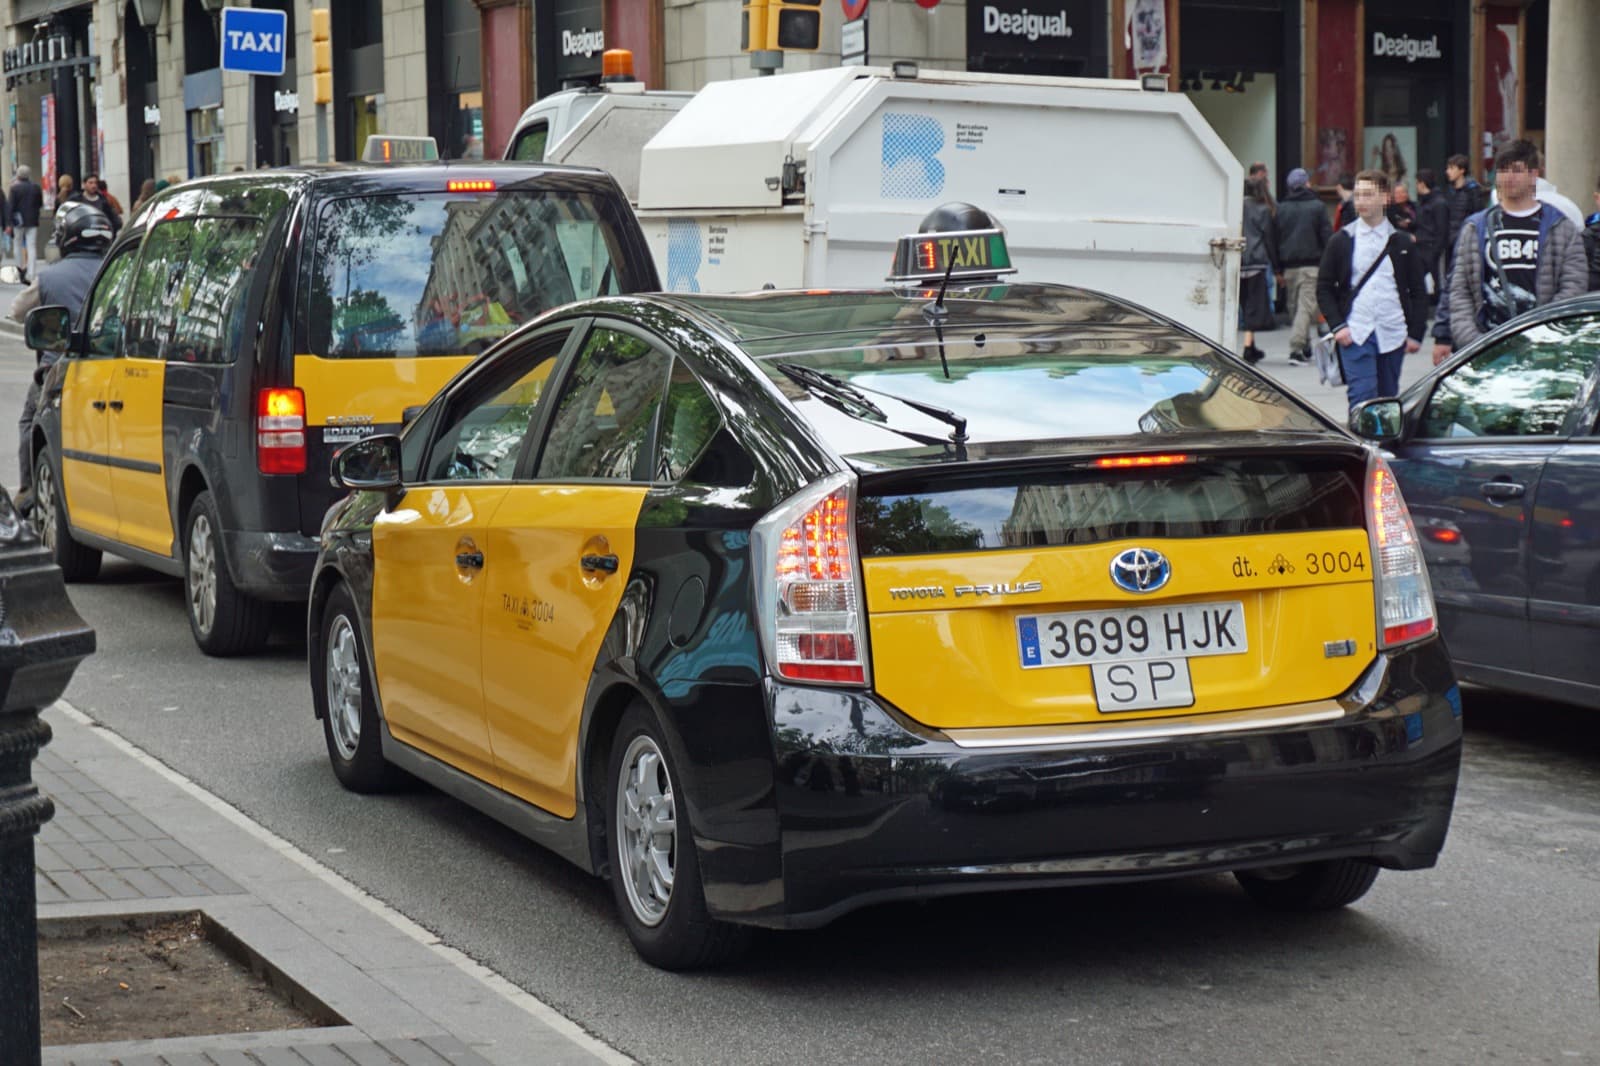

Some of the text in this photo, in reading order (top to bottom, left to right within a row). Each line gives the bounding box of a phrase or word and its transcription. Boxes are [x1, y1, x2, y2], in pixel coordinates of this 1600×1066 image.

[228, 30, 281, 53] TAXI
[562, 27, 604, 58] Desigua
[383, 141, 424, 162] 1 TAXI
[924, 237, 987, 269] 1 TAXI
[1232, 551, 1366, 578] dt. 3004
[889, 581, 1042, 600] TOYOTA PRIUS
[502, 593, 554, 623] TAXI 3004
[1027, 608, 1236, 659] E 3699 HJK
